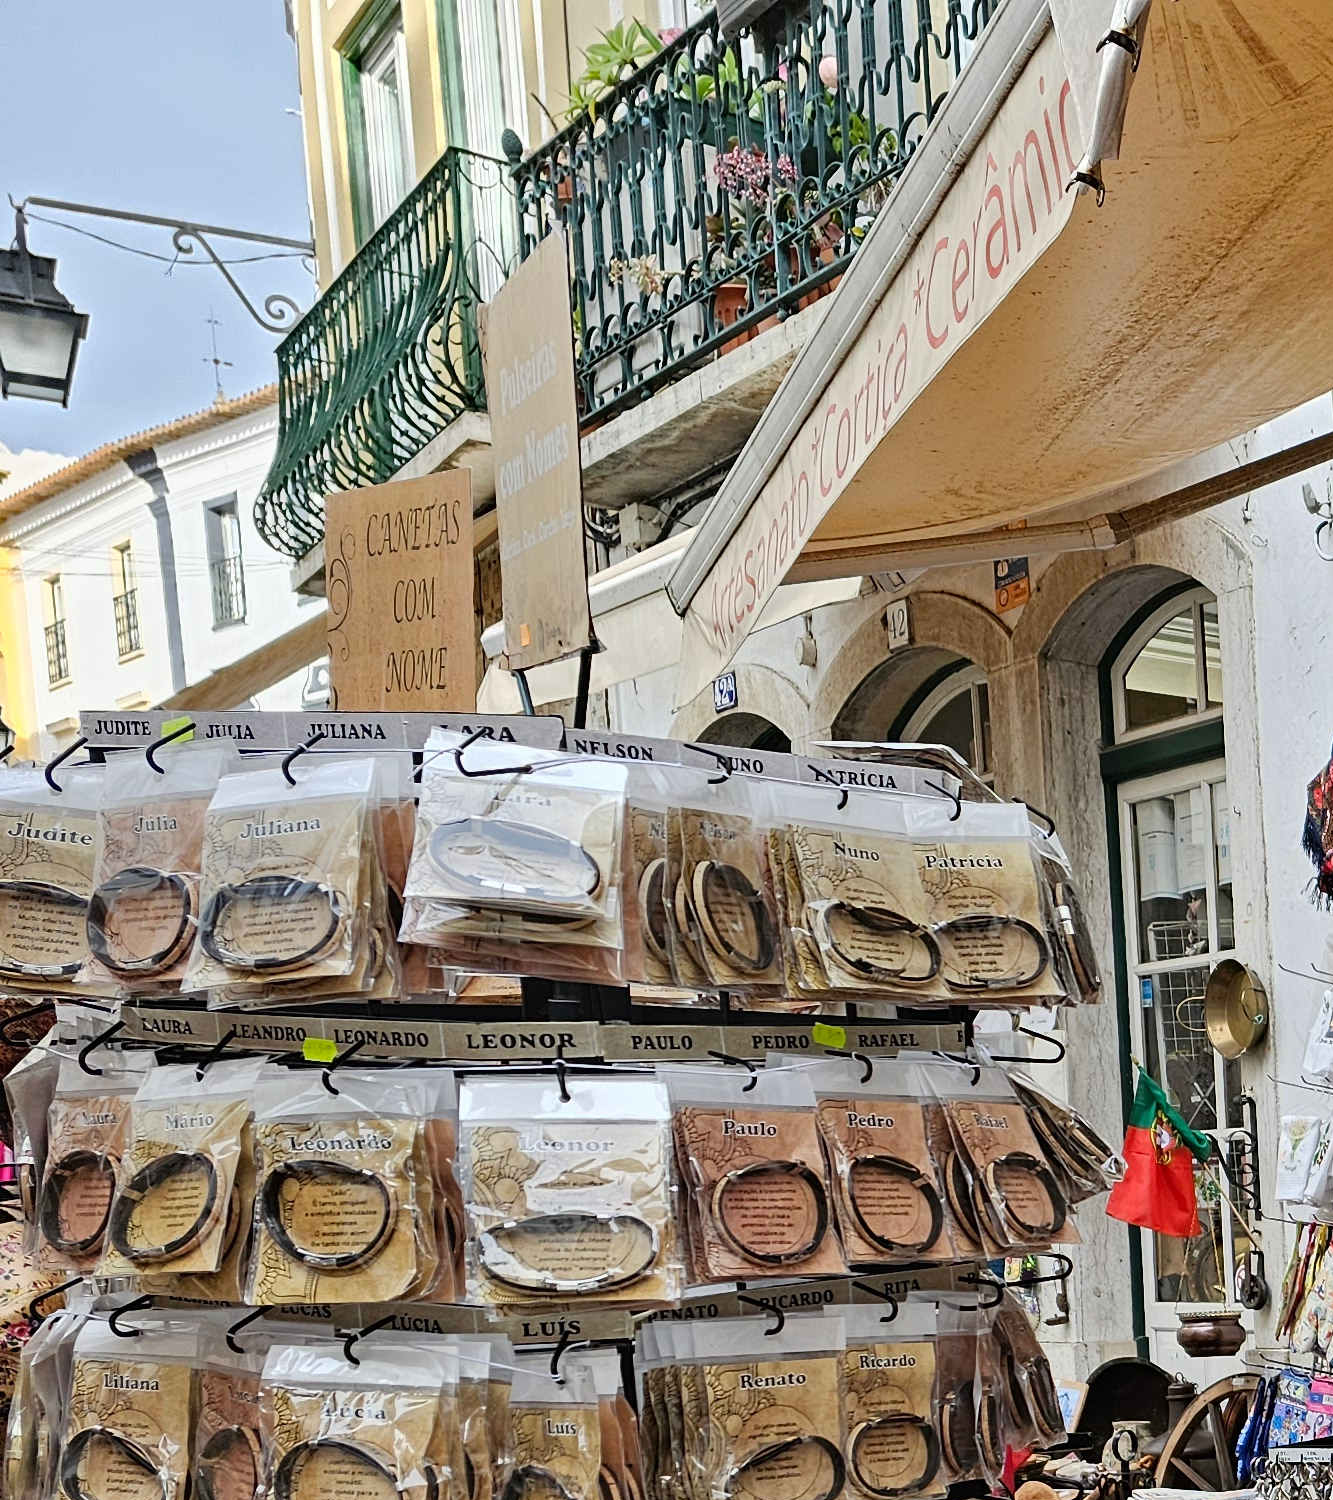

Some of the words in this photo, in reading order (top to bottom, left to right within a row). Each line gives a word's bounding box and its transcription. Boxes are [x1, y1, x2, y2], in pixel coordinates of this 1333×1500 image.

[501, 455, 525, 499] com
[524, 421, 569, 479] Nomes
[365, 498, 461, 558] CANETAS
[710, 468, 809, 648] Artesanato
[393, 580, 437, 624] COM
[887, 607, 905, 640] 42
[384, 644, 448, 693] NOME
[95, 719, 152, 736] JUDITE
[307, 722, 386, 741] JULIANA
[442, 725, 516, 743] ARA
[574, 738, 654, 761] NELSON
[716, 755, 764, 774] NUNO
[814, 767, 898, 789] PATRÍCIA
[7, 821, 94, 847] Judite
[240, 815, 322, 841] Juliana
[833, 841, 880, 863] Nuno
[925, 853, 1004, 871] Patrícia
[142, 1016, 193, 1036] LAURA
[231, 1023, 307, 1042] LEANDRO
[334, 1028, 429, 1048] LEONARDO
[466, 1032, 576, 1051] LEONOR
[631, 1034, 693, 1051] PAULO
[752, 1034, 809, 1050] PEDRO
[858, 1031, 919, 1048] RAFAEL
[164, 1112, 215, 1131] Mário
[722, 1119, 777, 1138] Paulo
[847, 1111, 894, 1130] Pedro
[290, 1132, 392, 1153] Leonardo
[760, 1289, 834, 1311] RICARDO
[885, 1278, 921, 1295] RITA
[279, 1303, 332, 1320] LUCAS
[389, 1312, 443, 1334] LÚCIA
[523, 1318, 580, 1339] LUÍS
[858, 1352, 916, 1369] Ricardo
[103, 1373, 160, 1392] Liliana
[740, 1371, 806, 1390] Renato
[325, 1401, 386, 1421] Lúcia
